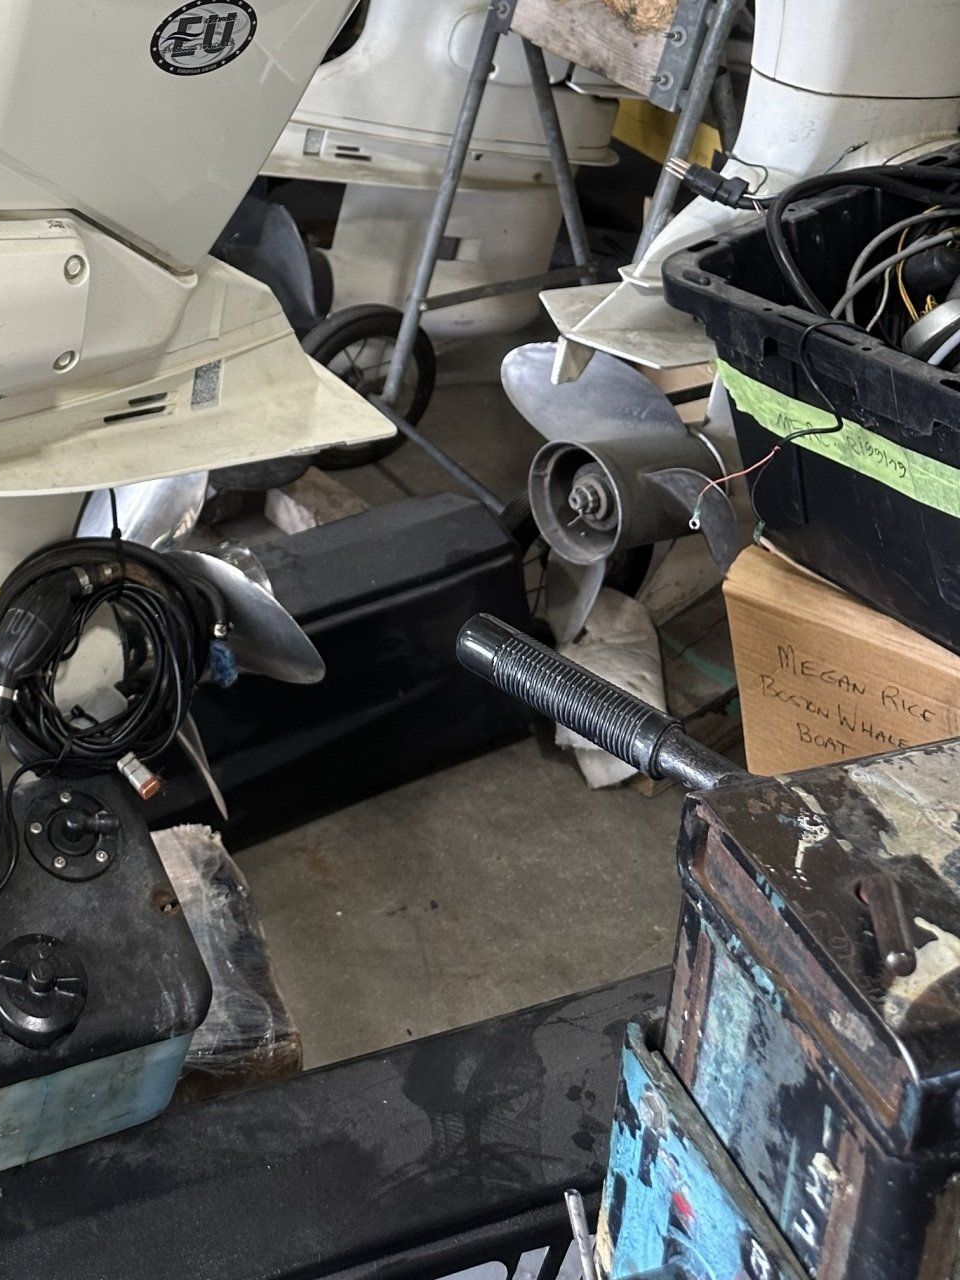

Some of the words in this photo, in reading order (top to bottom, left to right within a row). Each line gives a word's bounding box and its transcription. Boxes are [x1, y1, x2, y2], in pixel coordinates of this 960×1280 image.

[777, 643, 866, 696] MEGAN
[881, 684, 937, 723] RICE
[796, 721, 854, 756] BOAT
